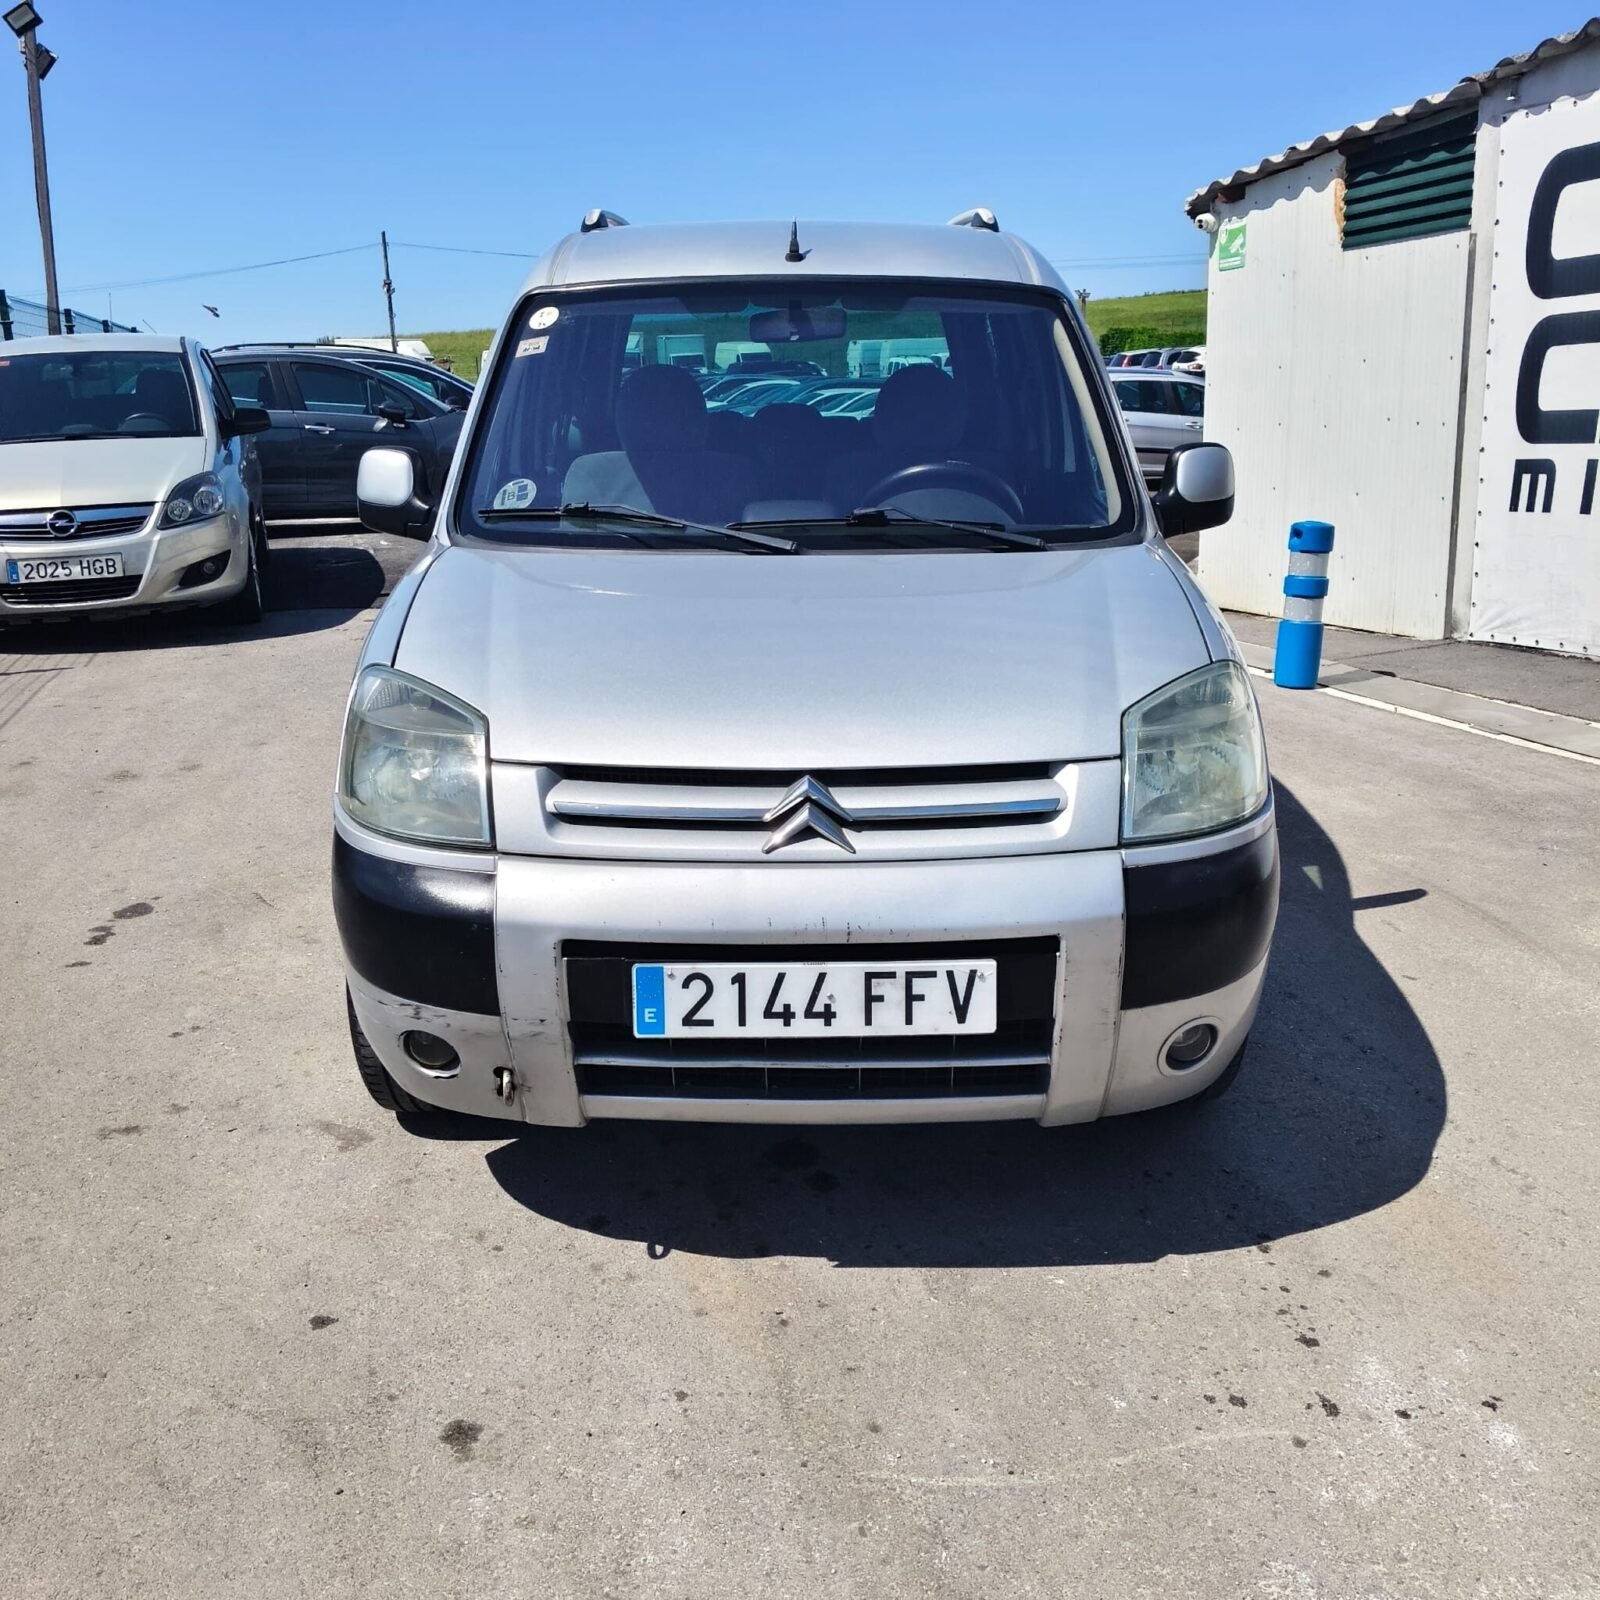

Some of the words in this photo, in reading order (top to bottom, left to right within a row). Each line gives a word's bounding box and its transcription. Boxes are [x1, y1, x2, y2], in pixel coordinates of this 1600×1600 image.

[23, 560, 72, 580] 2025
[79, 558, 117, 576] HGB
[645, 1008, 656, 1022] E
[682, 972, 836, 1027] 2144
[864, 969, 978, 1026] FFV
